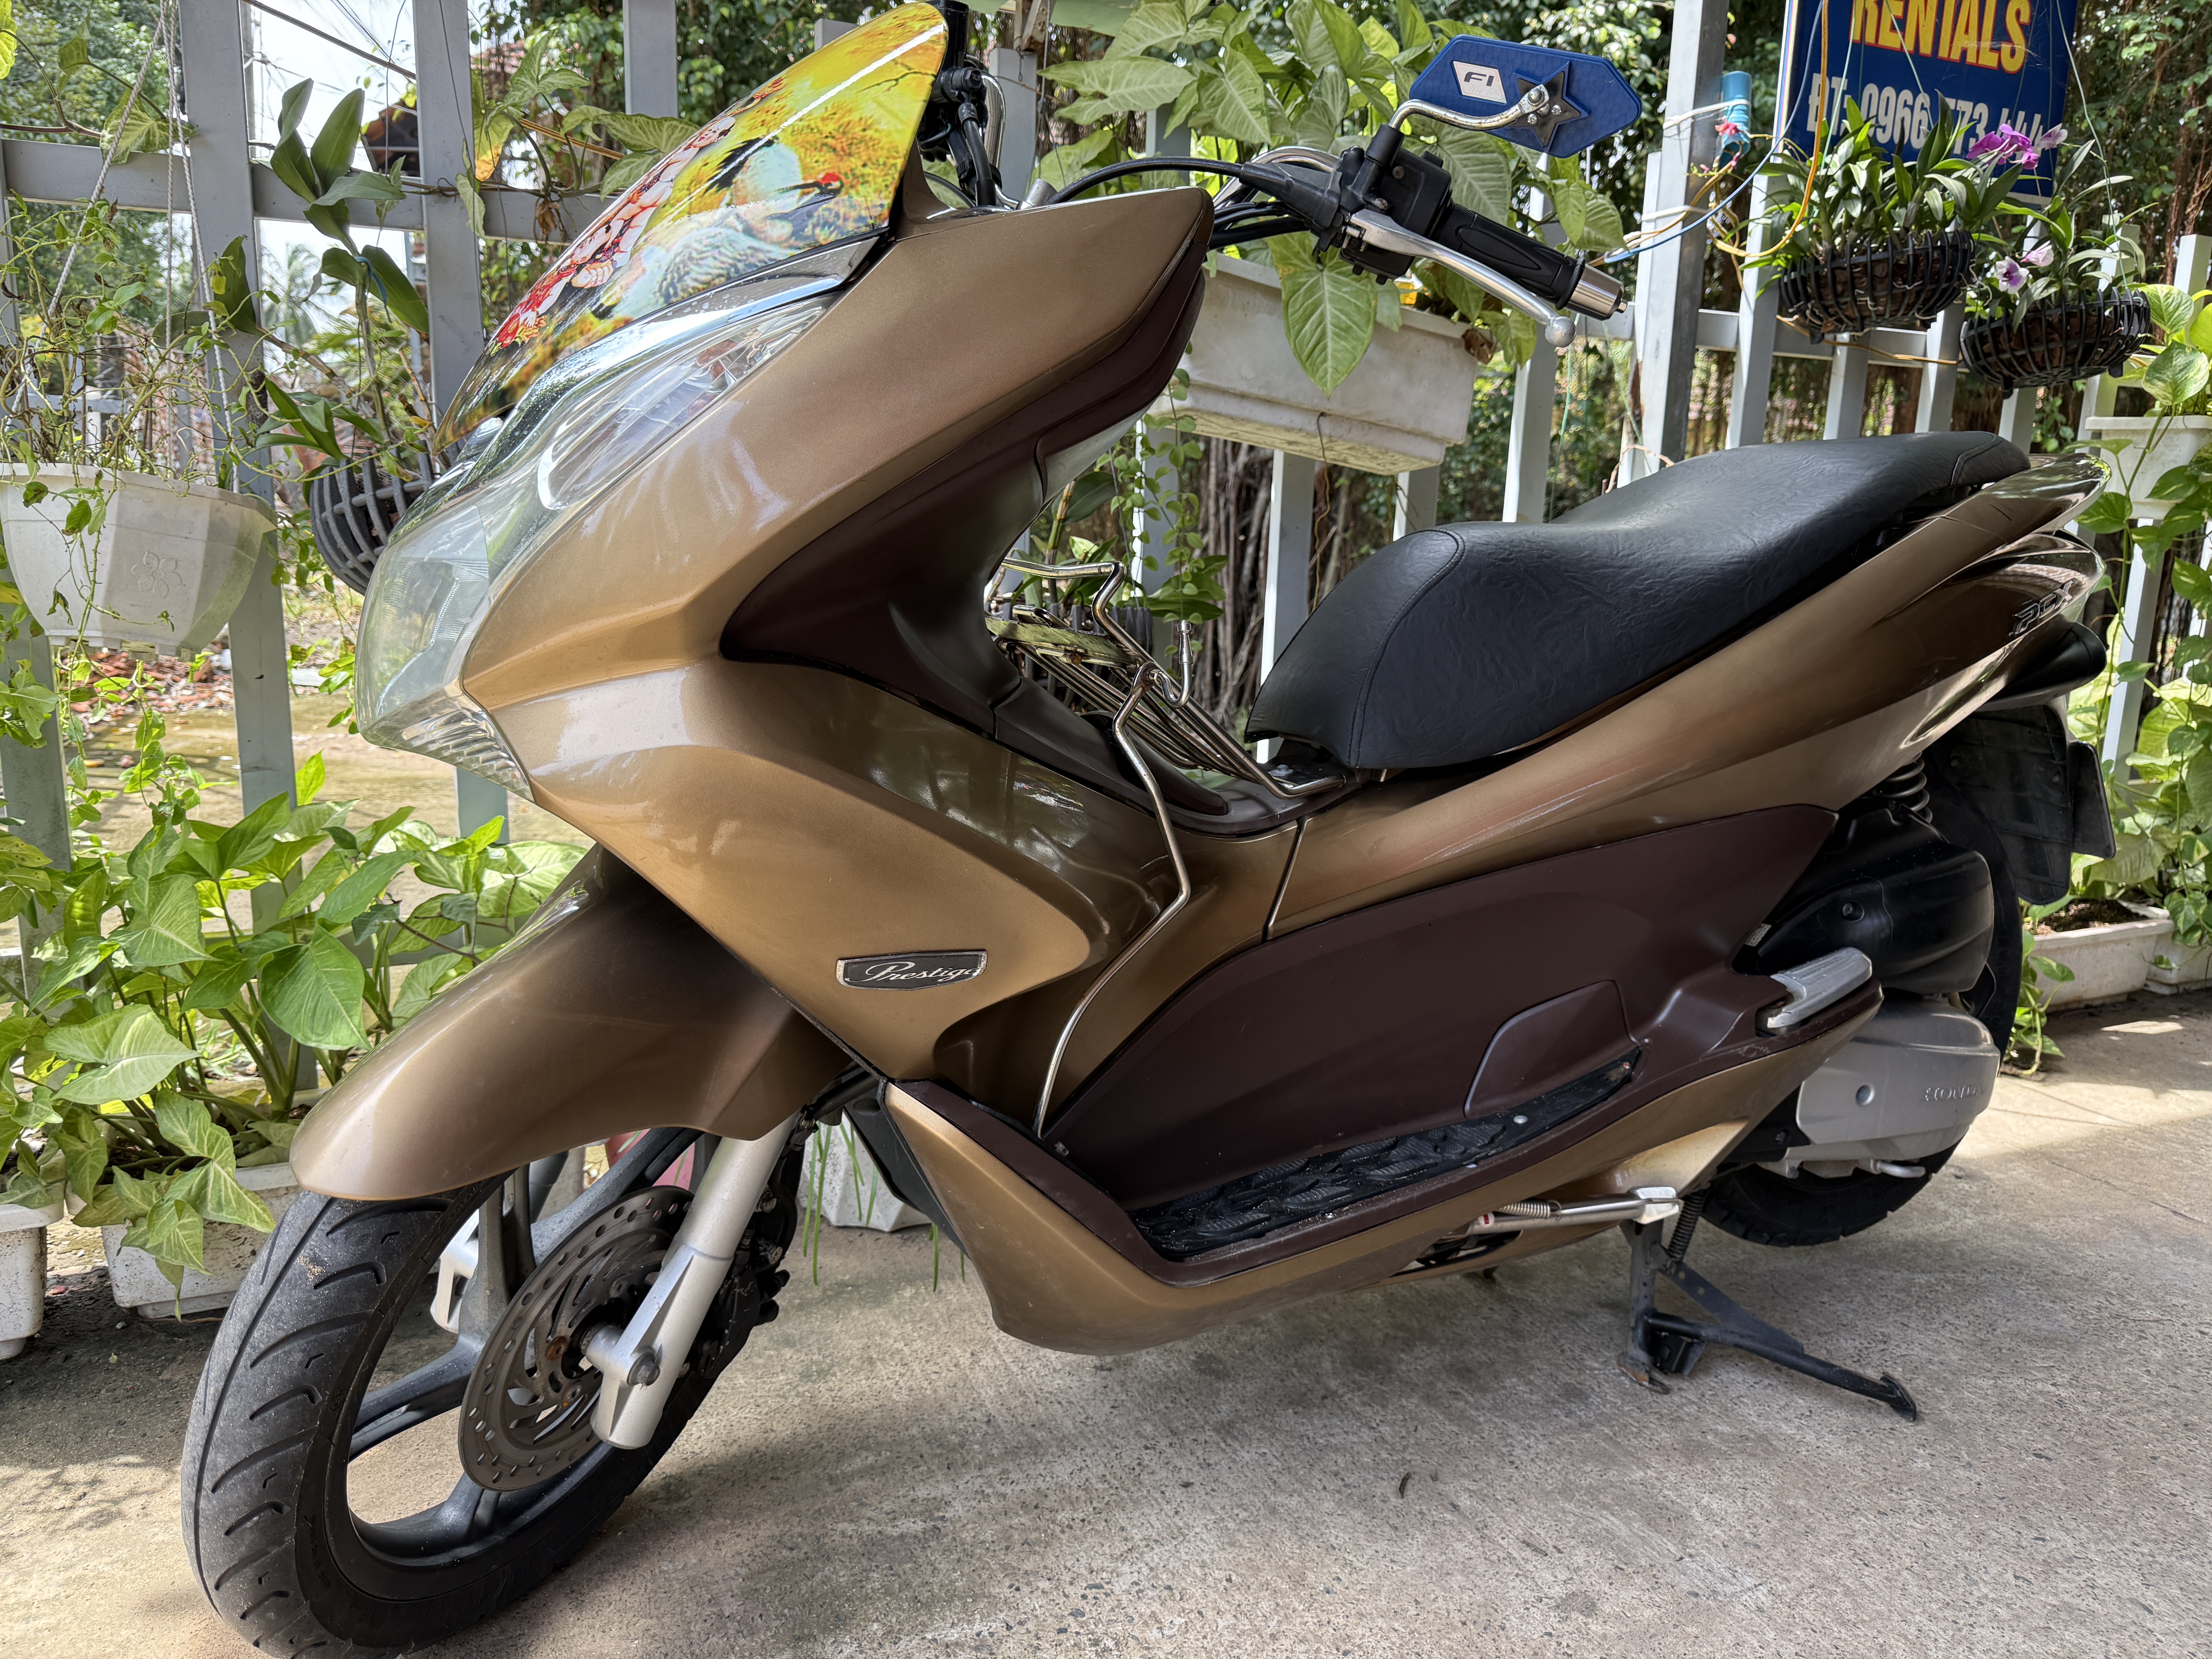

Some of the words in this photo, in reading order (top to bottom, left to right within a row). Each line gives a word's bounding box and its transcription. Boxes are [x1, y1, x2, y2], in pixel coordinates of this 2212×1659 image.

[1860, 83, 1930, 149] 0966
[1944, 97, 1989, 155] 73
[2012, 577, 2077, 634] PCX
[845, 961, 979, 982] Prestige
